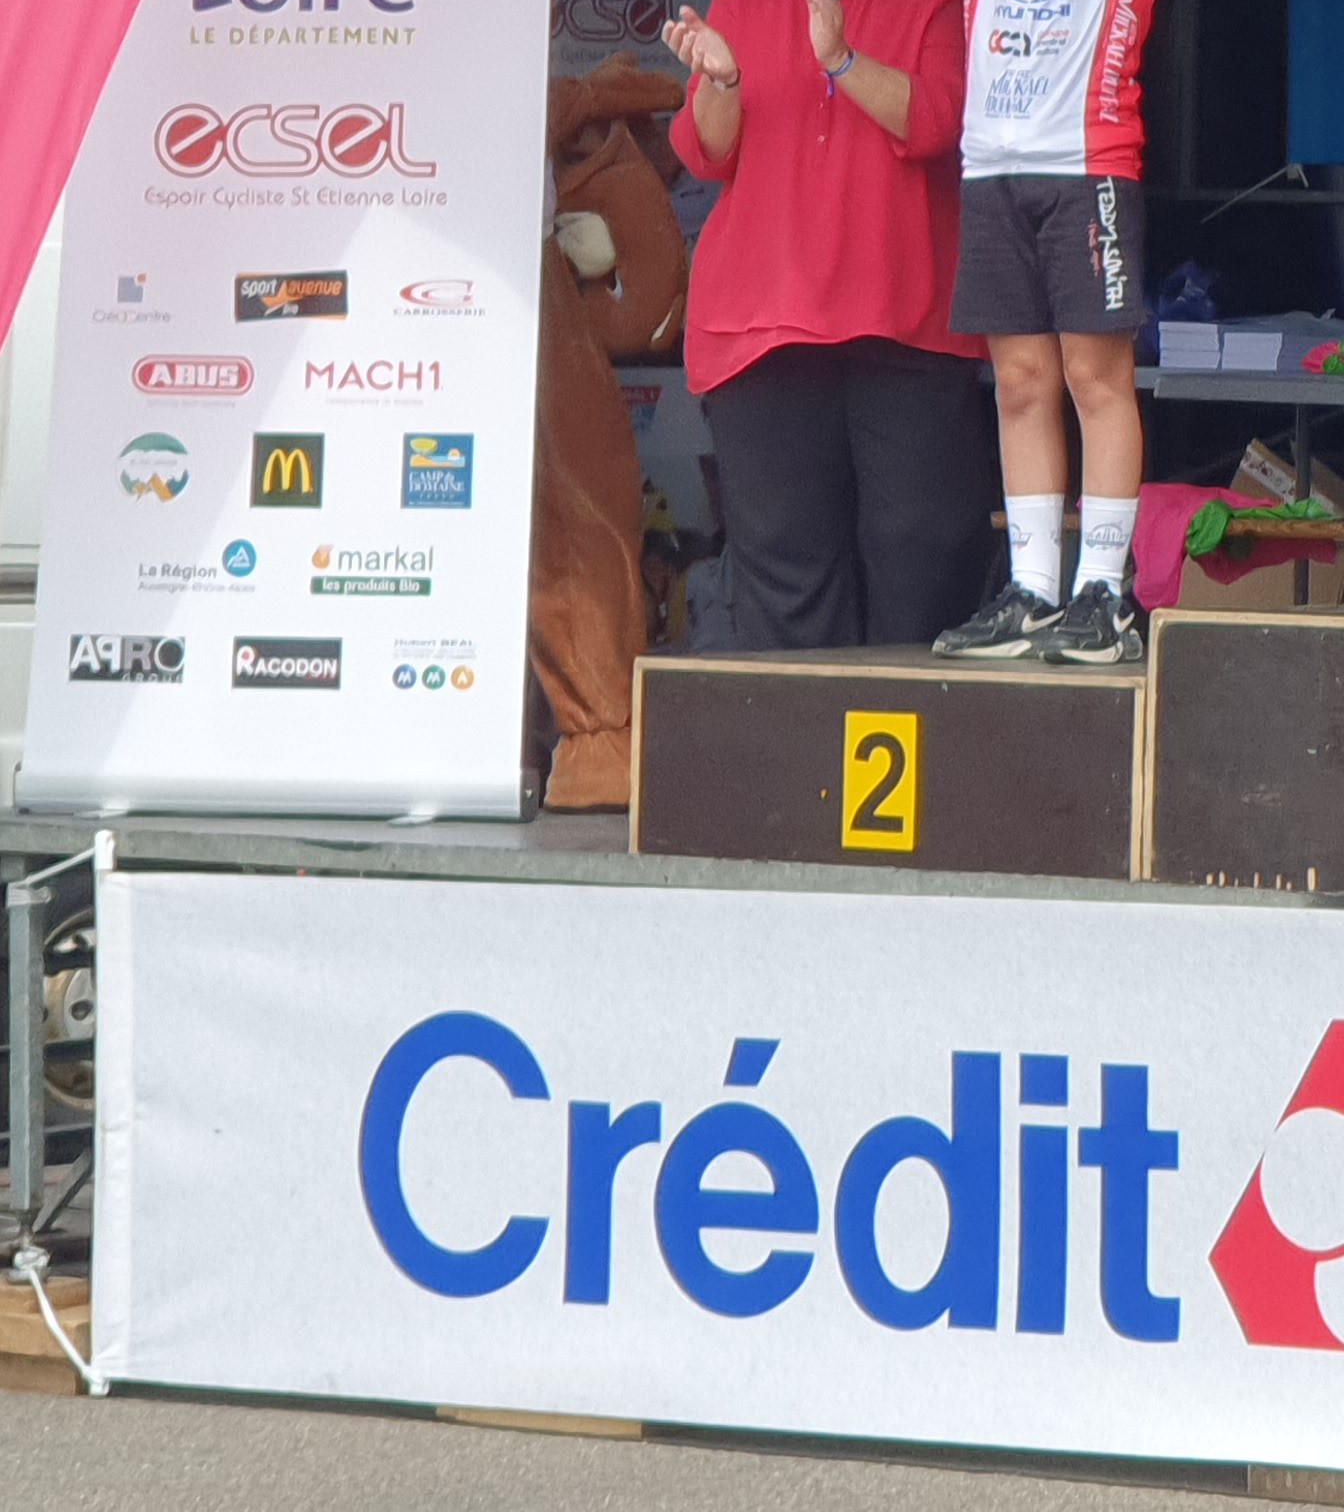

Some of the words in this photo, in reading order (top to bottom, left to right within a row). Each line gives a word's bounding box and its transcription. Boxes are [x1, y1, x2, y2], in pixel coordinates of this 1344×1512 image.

[190, 26, 213, 46] LE
[229, 23, 417, 47] DÉPARTEMENT
[143, 187, 205, 208] Espoir
[212, 188, 286, 210] Cycliste
[291, 188, 310, 206] St
[402, 189, 449, 206] Loire
[148, 363, 241, 389] ABUS
[304, 360, 442, 392] MACH1
[337, 544, 434, 572] markal
[857, 733, 904, 832] 2
[363, 1012, 1181, 1343] Crédit
